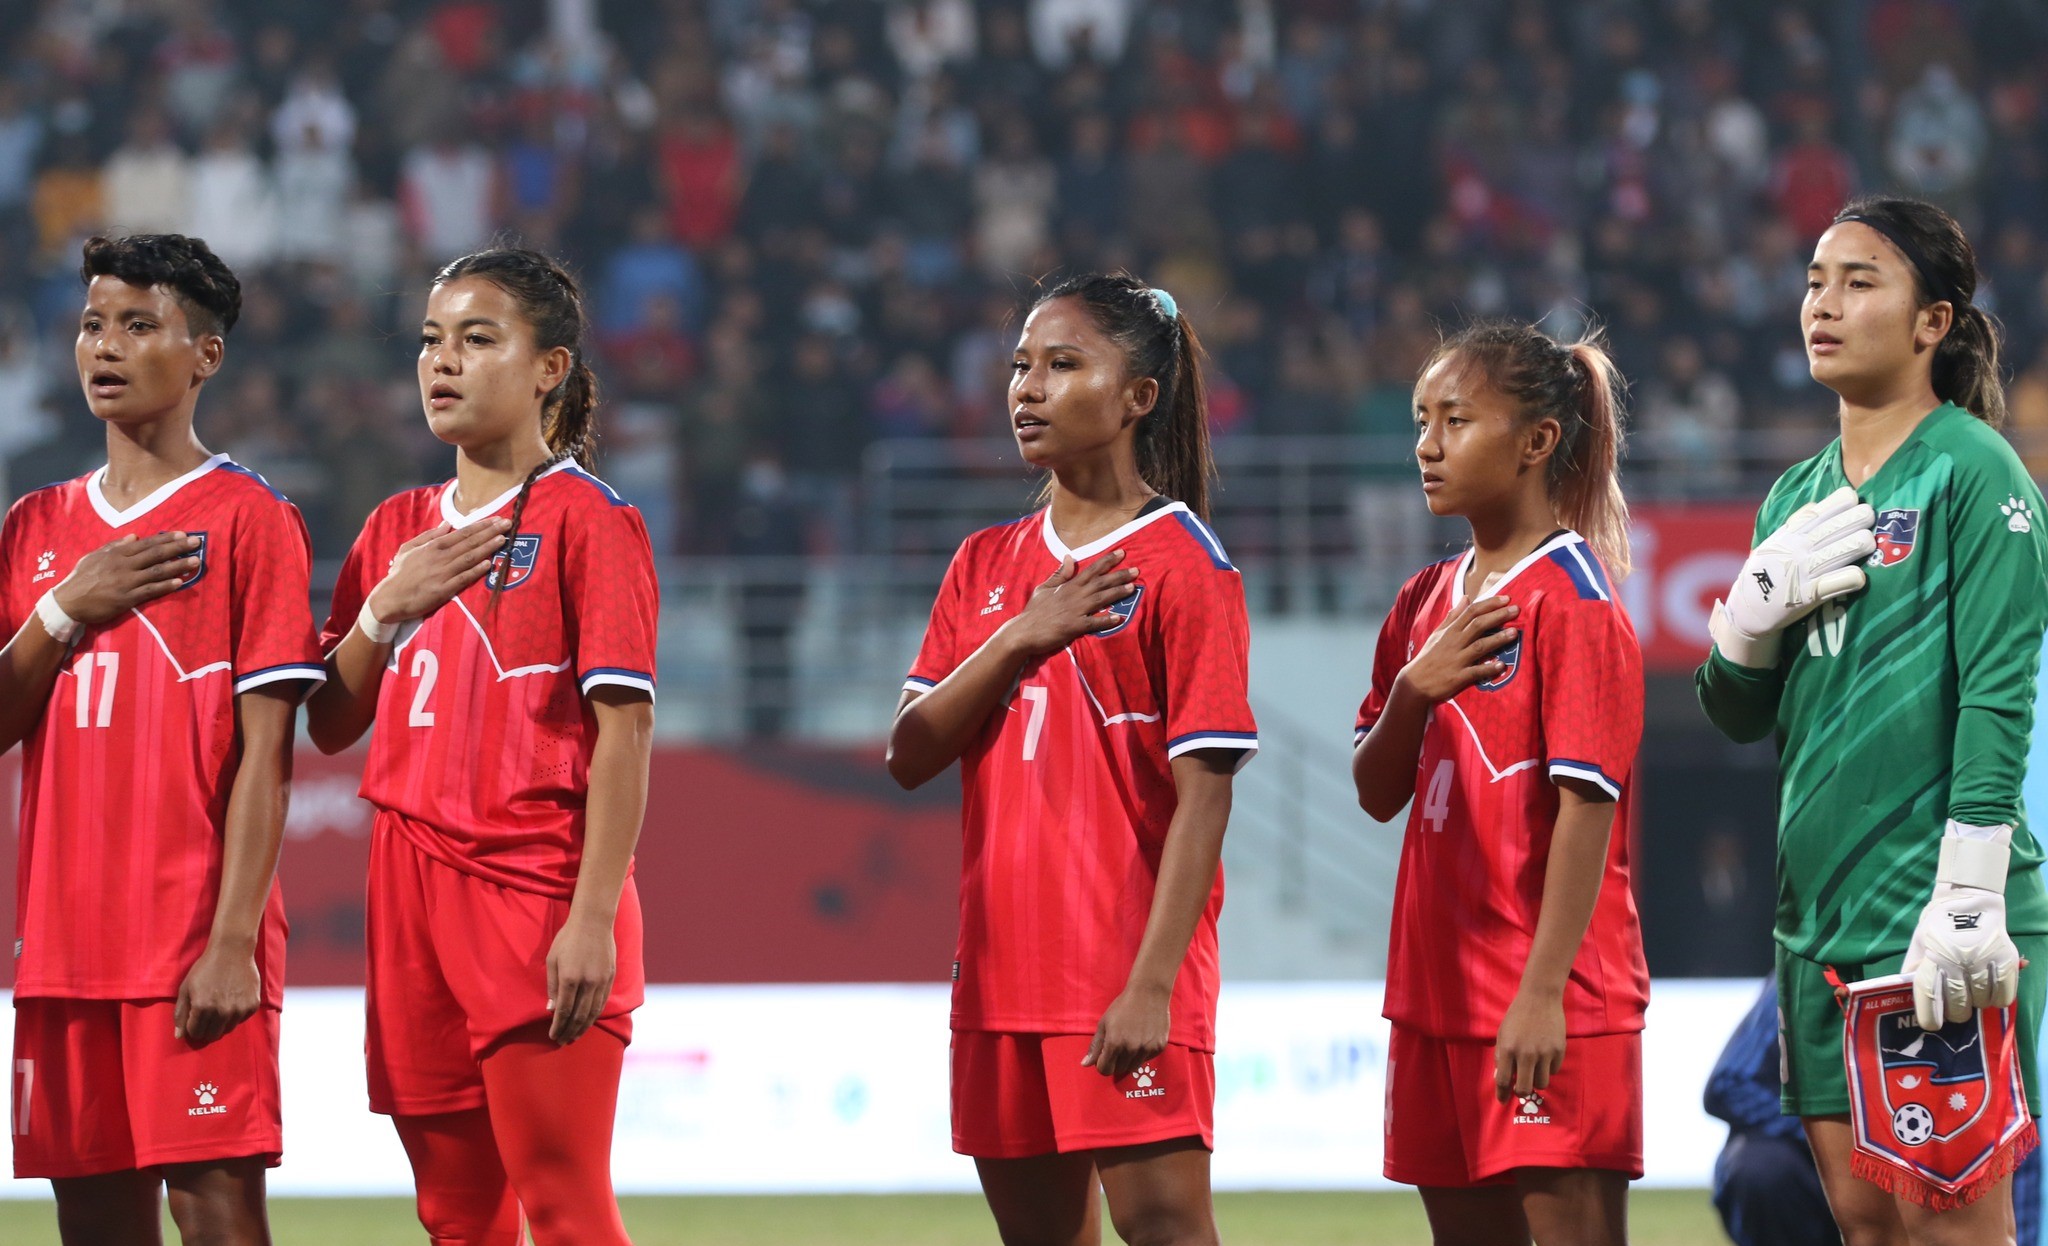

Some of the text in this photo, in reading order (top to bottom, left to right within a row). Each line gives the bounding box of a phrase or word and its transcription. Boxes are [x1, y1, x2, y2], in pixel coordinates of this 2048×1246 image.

[72, 652, 120, 729] 17
[408, 648, 439, 728] 2
[1021, 684, 1048, 761] 7
[1420, 757, 1455, 833] 4
[1864, 1000, 1879, 1010] ALL
[1880, 995, 1904, 1008] NEPAL
[1897, 1014, 1919, 1029] NE
[11, 1058, 35, 1136] 7
[188, 1105, 227, 1116] KELME
[1125, 1087, 1166, 1099] KELME
[1512, 1115, 1551, 1125] KELME
